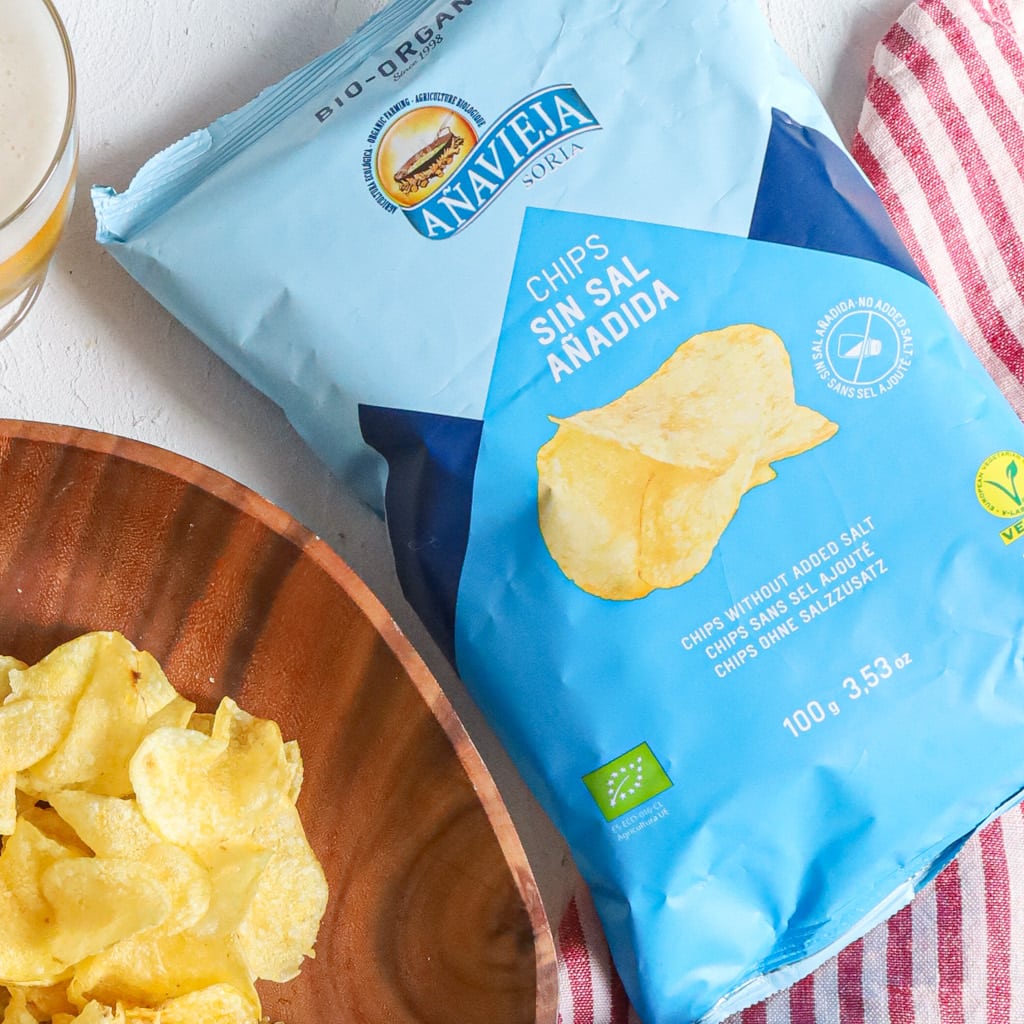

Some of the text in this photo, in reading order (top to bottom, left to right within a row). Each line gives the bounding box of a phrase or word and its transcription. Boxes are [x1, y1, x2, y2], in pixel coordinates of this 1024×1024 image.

[314, 0, 473, 123] BIO-ORGAN
[393, 34, 444, 82] Since 1998
[384, 98, 410, 120] FARMING
[415, 92, 458, 104] AGRICULTURE
[456, 97, 486, 128] BIOLOGIQUE
[367, 116, 387, 143] ORGANIC
[421, 95, 594, 238] AÑAVIEJA
[521, 142, 584, 189] SORIA
[367, 179, 398, 214] AGRICULTURA
[526, 234, 609, 302] CHIPS
[530, 255, 651, 345] SIN SAL
[858, 296, 874, 308] NO
[875, 299, 906, 328] ADDED
[546, 279, 680, 384] AÑADIDA
[901, 327, 914, 356] SALT
[811, 340, 824, 361] SAL
[814, 360, 831, 381] SIN
[827, 378, 855, 399] SANS
[857, 387, 877, 399] SEL
[680, 515, 875, 651] CHIPS WITHOUT ADDED SALT
[705, 541, 875, 660] CHIPS SANS SEL AJOUTÉ
[714, 558, 889, 678] CHIPS OHNE SALZZUSATZ
[783, 652, 913, 738] 100 g 3,53 oz
